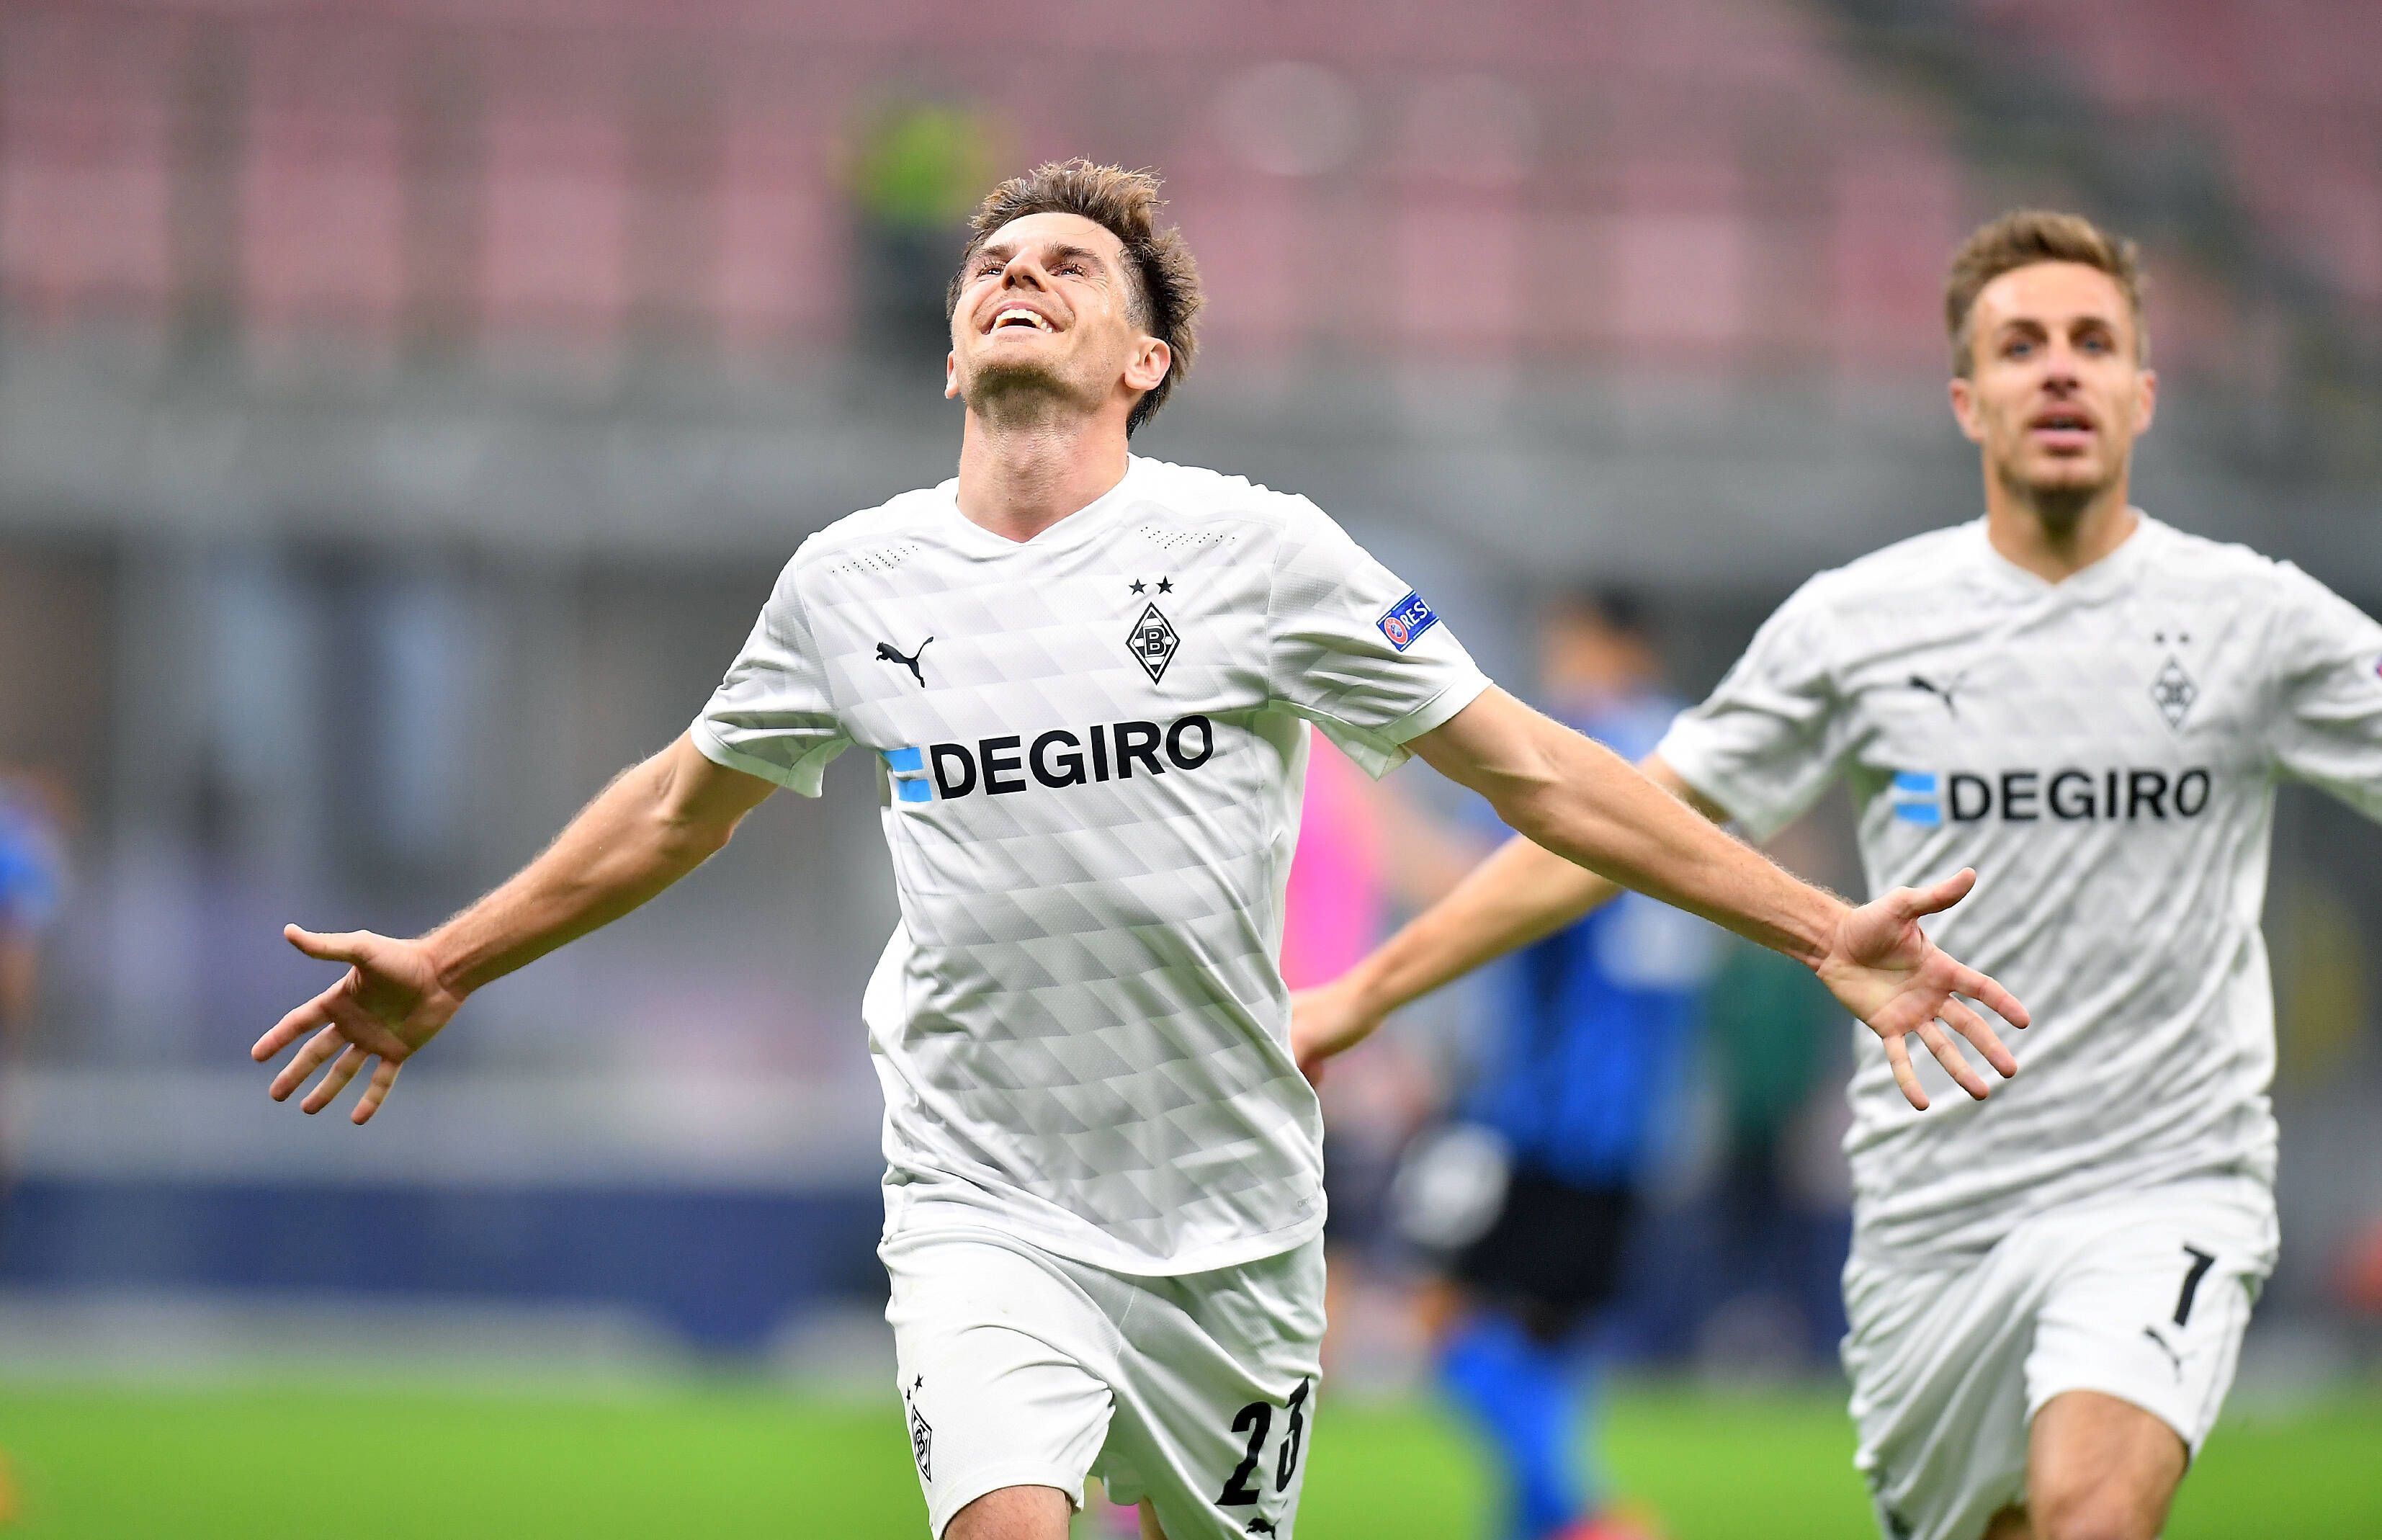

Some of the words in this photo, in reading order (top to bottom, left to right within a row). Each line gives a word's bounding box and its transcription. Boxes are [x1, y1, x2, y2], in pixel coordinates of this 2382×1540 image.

[1143, 625, 1166, 657] B
[929, 715, 1214, 800] DEGIRO
[1948, 768, 2212, 823] DEGIRO
[2172, 1242, 2216, 1328] 7
[1214, 1375, 1309, 1505] 23
